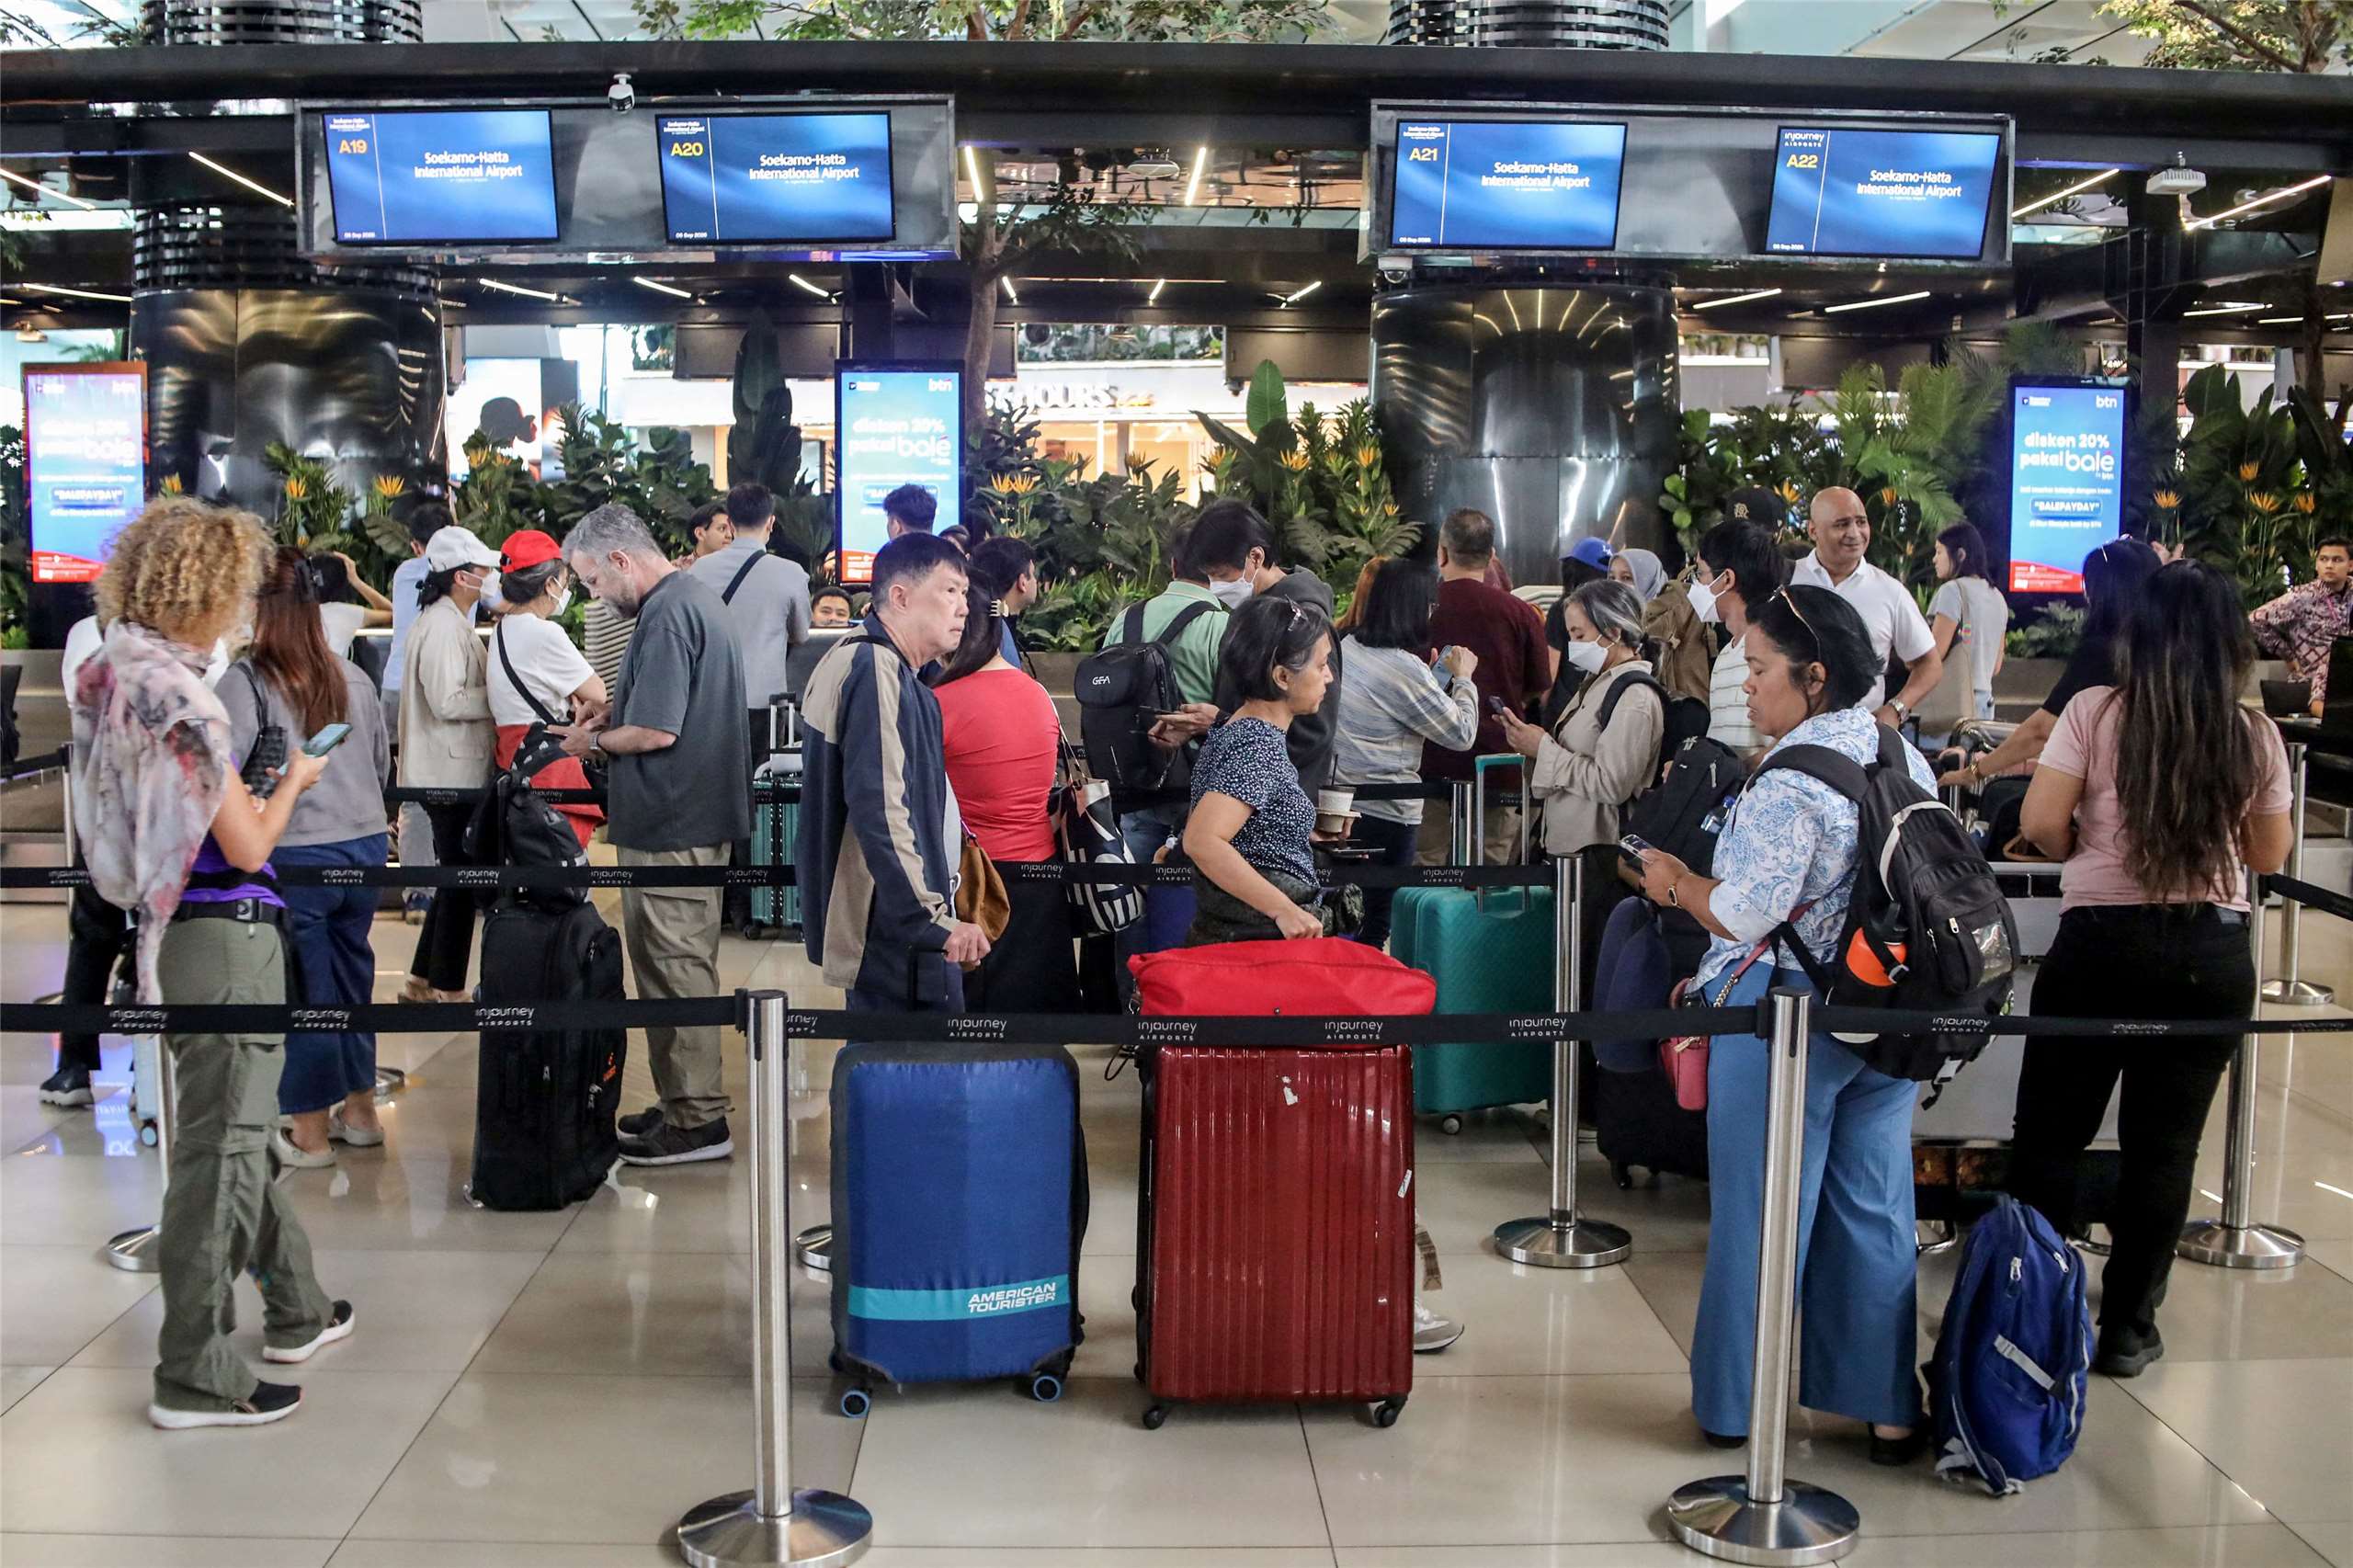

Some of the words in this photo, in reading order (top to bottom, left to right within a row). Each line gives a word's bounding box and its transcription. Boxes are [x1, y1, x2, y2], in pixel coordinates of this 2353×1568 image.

[1785, 132, 1824, 142] injourney
[339, 139, 368, 154] A19
[671, 142, 704, 156] A20
[1409, 147, 1438, 161] A21
[1787, 154, 1818, 168] A22
[415, 165, 483, 178] International
[485, 165, 522, 180] Airport
[749, 166, 819, 180] International
[822, 166, 859, 181] Airport
[1482, 175, 1552, 187] International
[1552, 176, 1590, 190] Airport
[1857, 183, 1924, 197] International
[1926, 185, 1961, 199] Airport
[928, 379, 952, 392] btn
[2096, 394, 2117, 408] btn
[2024, 430, 2075, 449] diskon
[2078, 433, 2109, 449] 20%
[1021, 864, 1063, 873] injourney
[1156, 867, 1191, 876] injourne
[475, 1007, 535, 1020] injourney
[948, 1017, 1007, 1031] injourney
[1138, 1021, 1198, 1034] injourney
[1324, 1021, 1383, 1032] injourney
[1509, 1017, 1567, 1030] injourney
[1932, 1017, 1991, 1028] injourney
[969, 1282, 1056, 1304] AMERICAN
[968, 1292, 1056, 1313] TOURISTER
